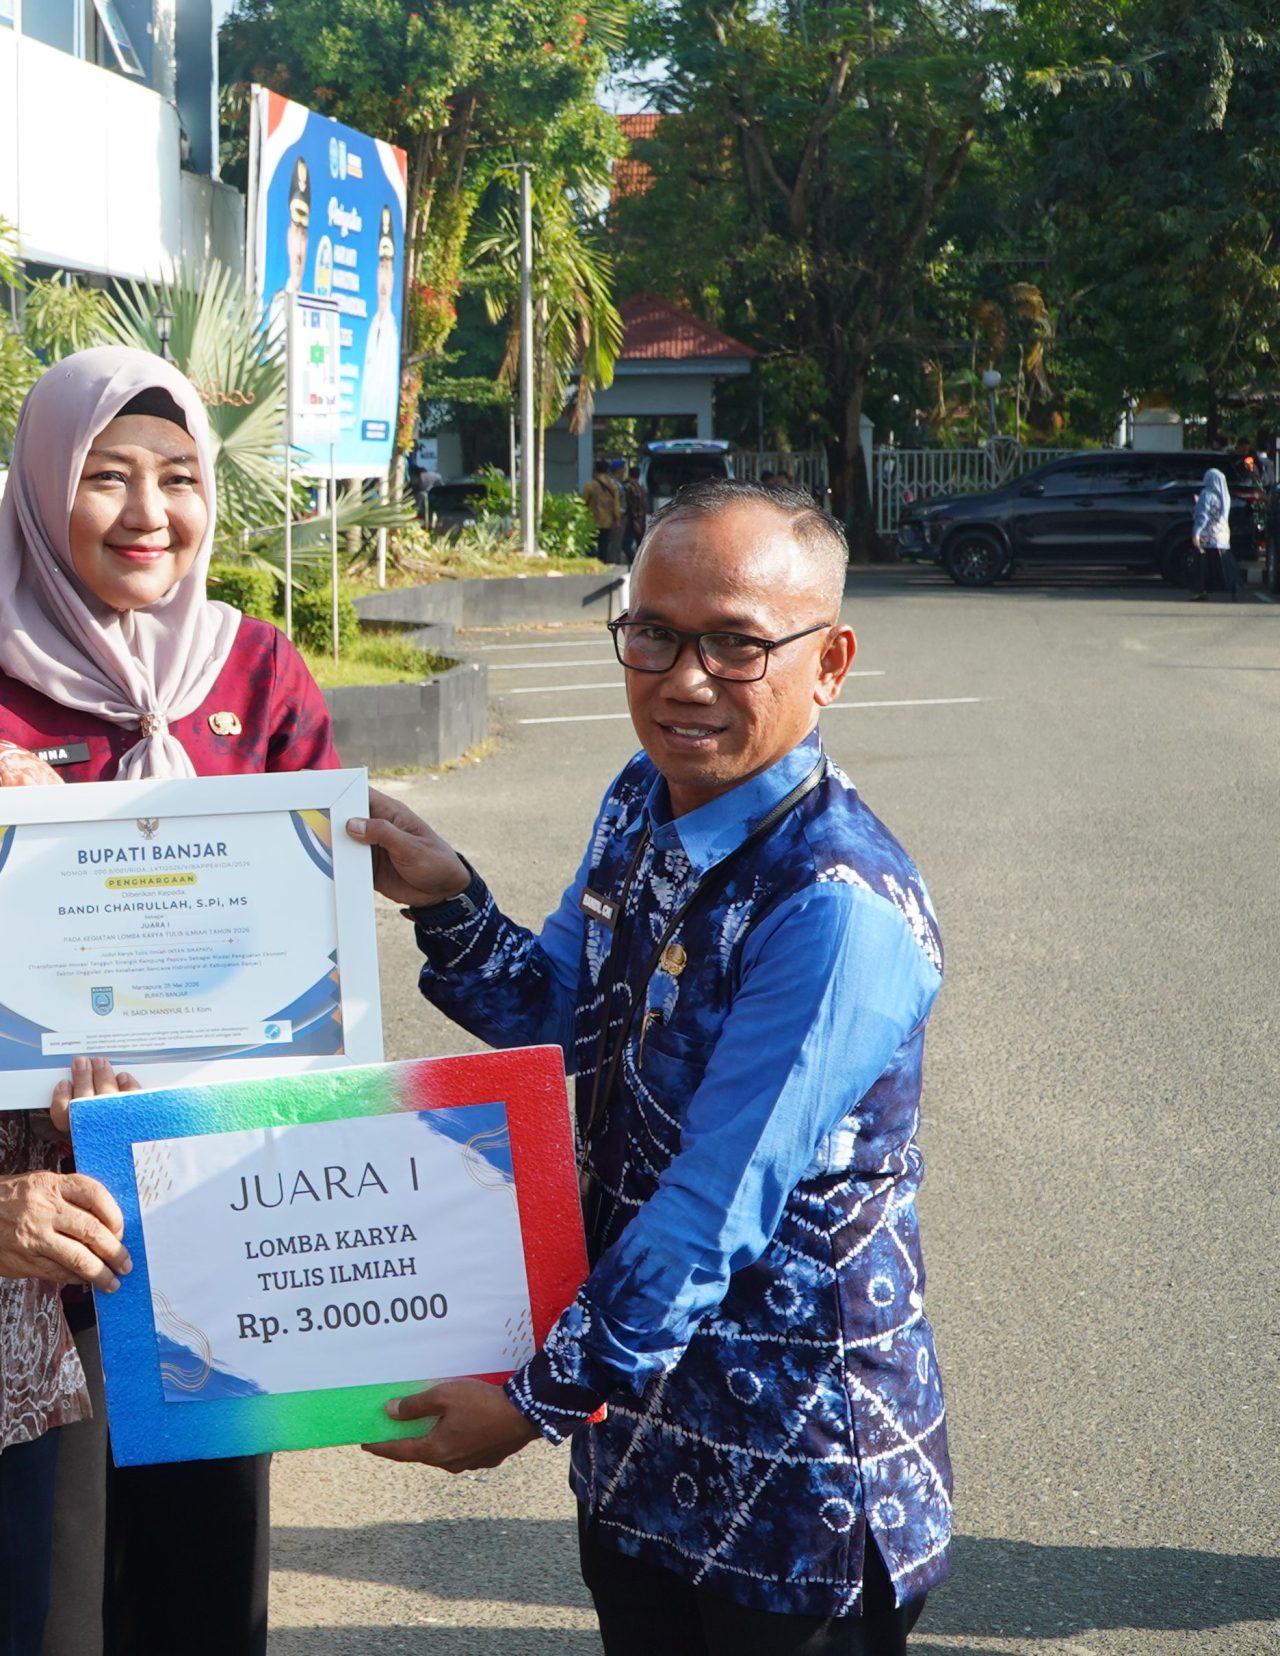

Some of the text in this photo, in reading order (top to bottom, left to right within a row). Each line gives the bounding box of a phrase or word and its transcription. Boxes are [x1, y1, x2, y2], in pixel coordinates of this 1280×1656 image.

[38, 748, 68, 761] NNA
[78, 842, 228, 864] BUPATI BANJAR
[109, 875, 195, 887] PENGHARGAAN
[58, 896, 248, 916] BANDI CHAIRULLAH, S.Pi, MS
[230, 1157, 419, 1211] JUARA I
[244, 1223, 418, 1260] LOMBA KARYA
[257, 1257, 417, 1291] TULIS ILMIAH
[236, 1293, 448, 1344] Rp. 3.000.000
